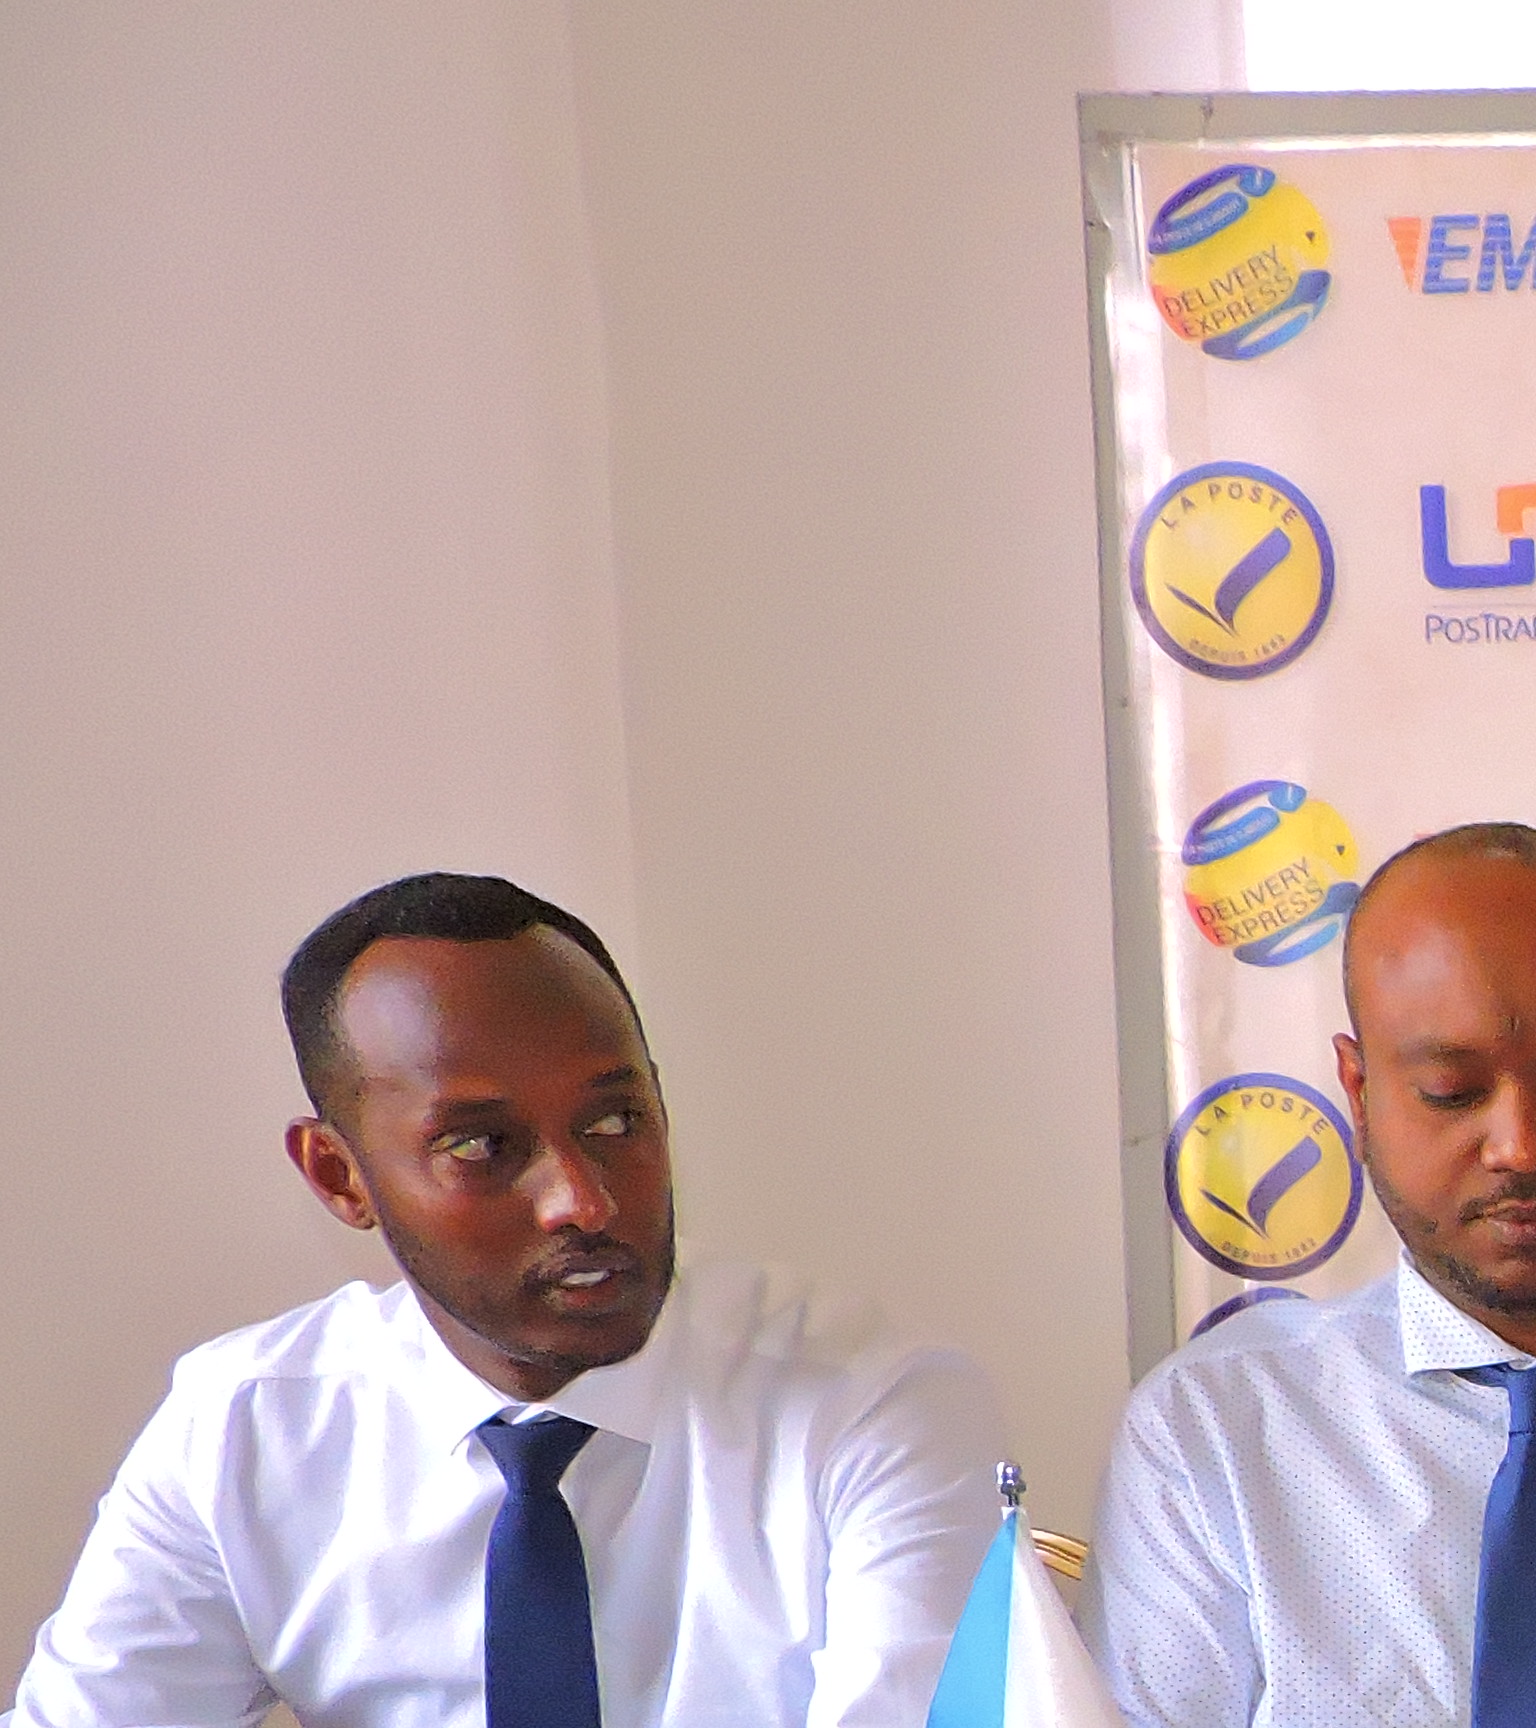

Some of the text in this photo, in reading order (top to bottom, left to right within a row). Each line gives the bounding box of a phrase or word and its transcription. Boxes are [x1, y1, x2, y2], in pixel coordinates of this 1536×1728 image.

[1164, 245, 1278, 317] DELIVERY
[1182, 267, 1292, 337] EXPRESS
[1161, 482, 1298, 529] LA POSTE
[1196, 856, 1309, 926] DELIVERY
[1213, 878, 1325, 946] EXPRESS
[1194, 1092, 1330, 1137] LA POSTE
